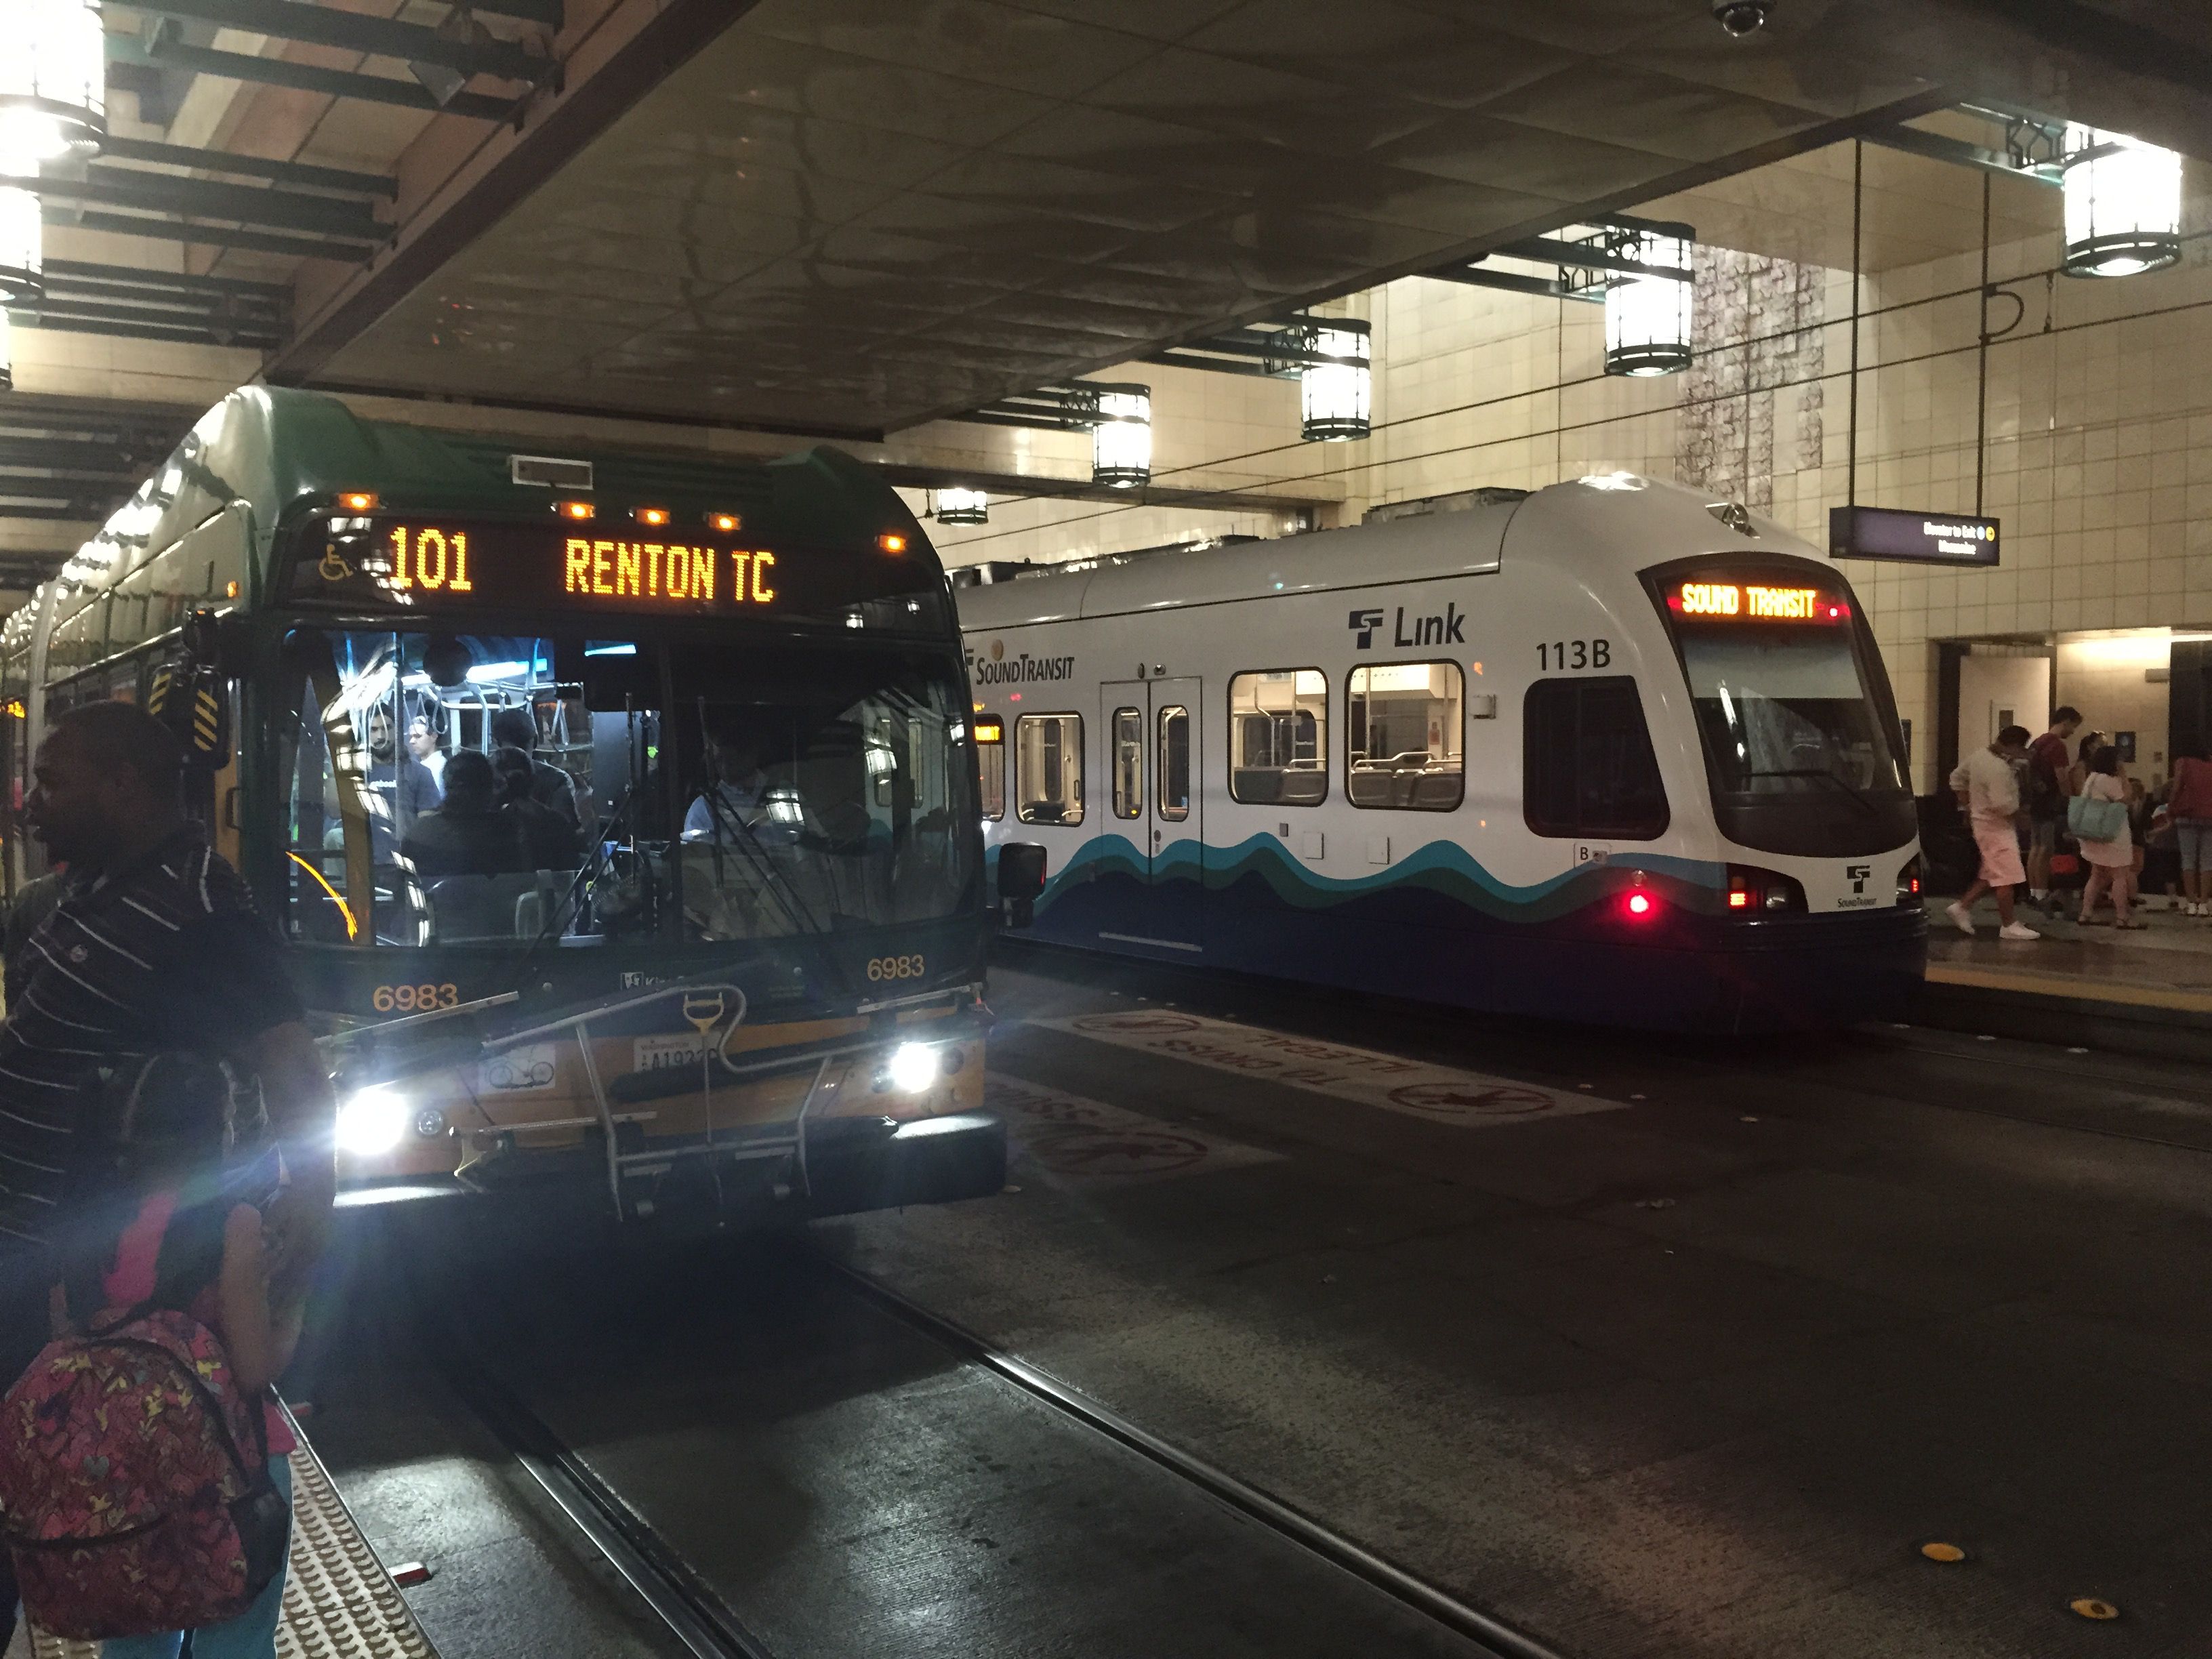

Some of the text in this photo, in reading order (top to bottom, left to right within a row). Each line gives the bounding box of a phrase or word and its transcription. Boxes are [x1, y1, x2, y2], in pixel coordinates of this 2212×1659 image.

[389, 527, 472, 592] 101
[565, 539, 775, 602] RENTON TC
[1681, 583, 1817, 618] SOUND TRANSIT
[1394, 602, 1465, 648] Link
[1536, 638, 1612, 672] 113B
[1580, 846, 1589, 861] B
[866, 954, 926, 981] 6983
[372, 983, 459, 1012] 6983
